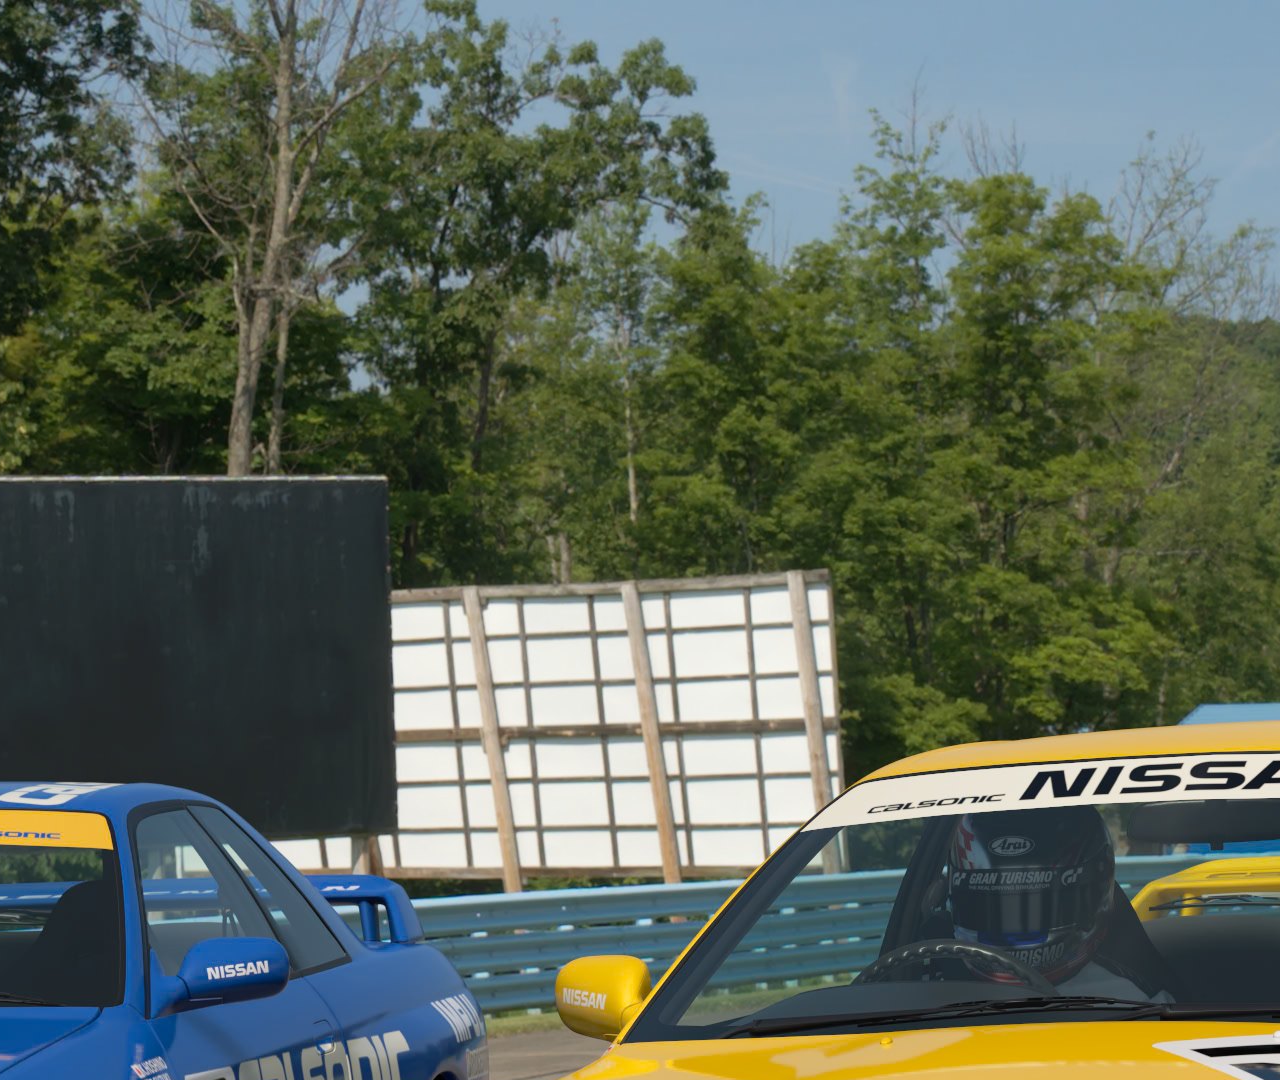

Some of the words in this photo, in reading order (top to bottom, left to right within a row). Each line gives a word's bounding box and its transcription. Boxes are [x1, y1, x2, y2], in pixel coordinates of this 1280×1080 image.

[969, 873, 997, 885] GRAN
[1000, 871, 1053, 883] TURISMO
[207, 960, 269, 980] NISSAN
[563, 987, 607, 1011] NISSAN
